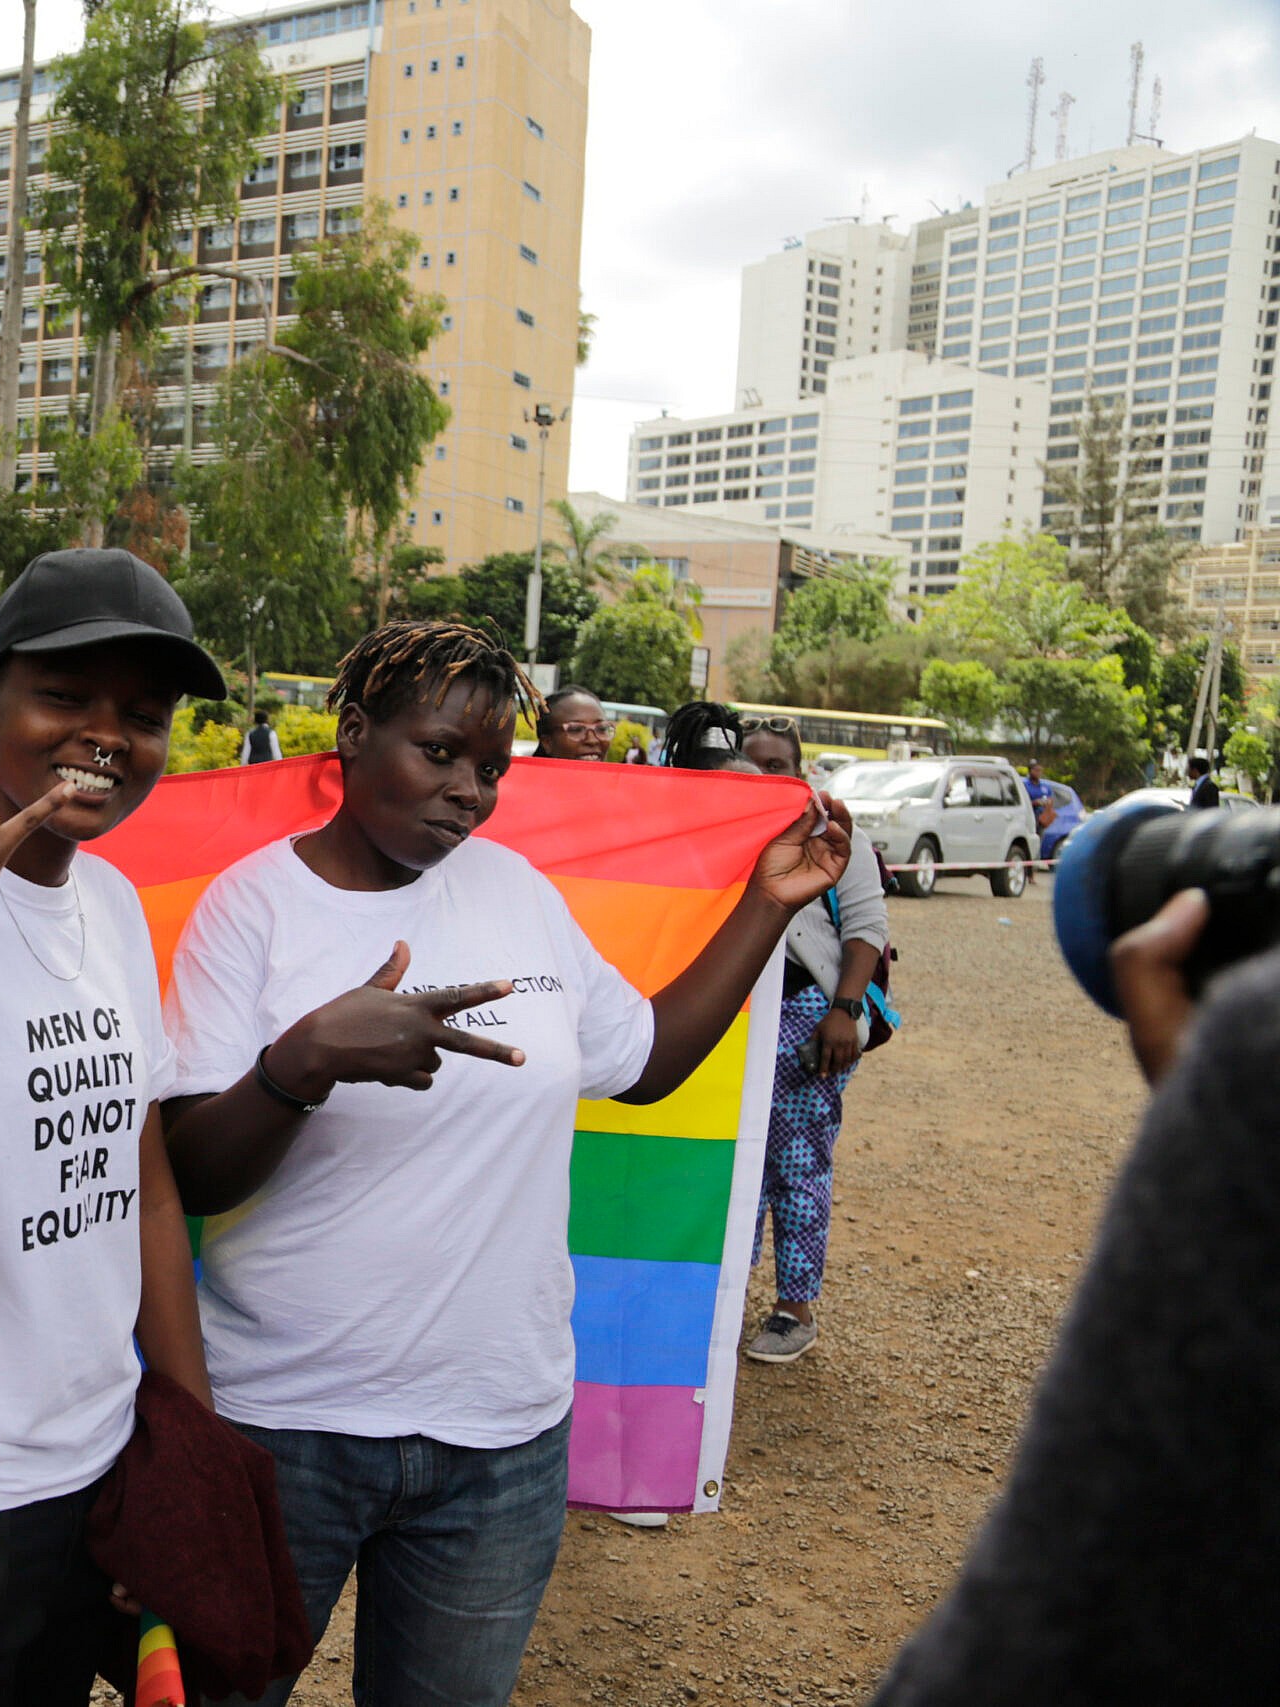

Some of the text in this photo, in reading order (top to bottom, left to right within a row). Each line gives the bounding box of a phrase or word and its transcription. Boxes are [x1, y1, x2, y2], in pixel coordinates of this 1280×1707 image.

[26, 1007, 121, 1053] MEN OF
[466, 1010, 507, 1027] ALL
[27, 1051, 133, 1103] QUALITY
[34, 1098, 136, 1151] DO NOT
[21, 1188, 137, 1252] EQUITY
